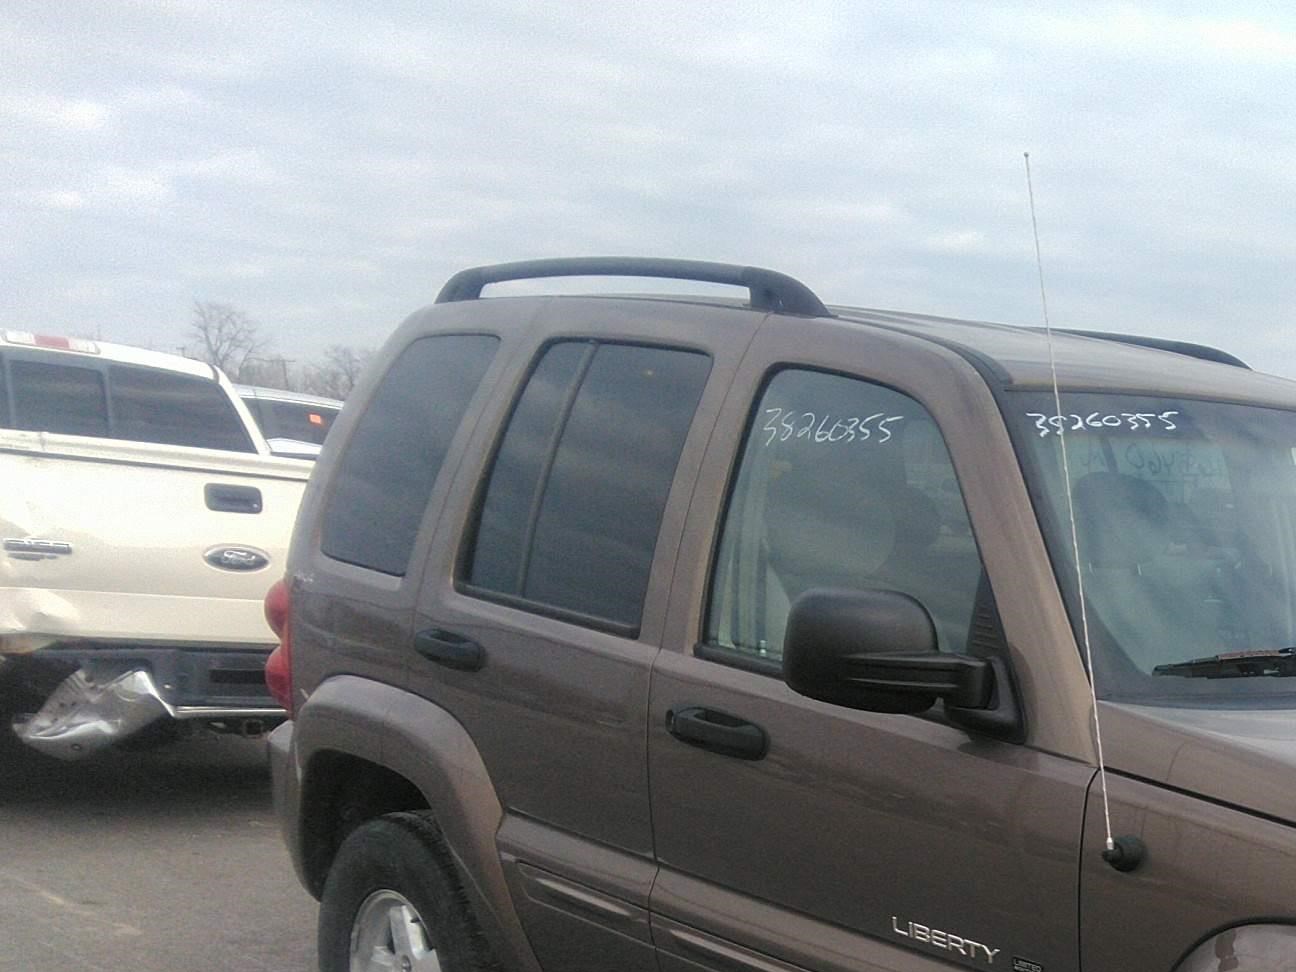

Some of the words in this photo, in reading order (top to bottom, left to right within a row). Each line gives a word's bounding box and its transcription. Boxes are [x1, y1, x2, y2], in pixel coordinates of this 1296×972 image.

[763, 407, 904, 447] 38260355
[1025, 411, 1179, 438] 38260355
[892, 916, 1000, 964] LIBERTY
